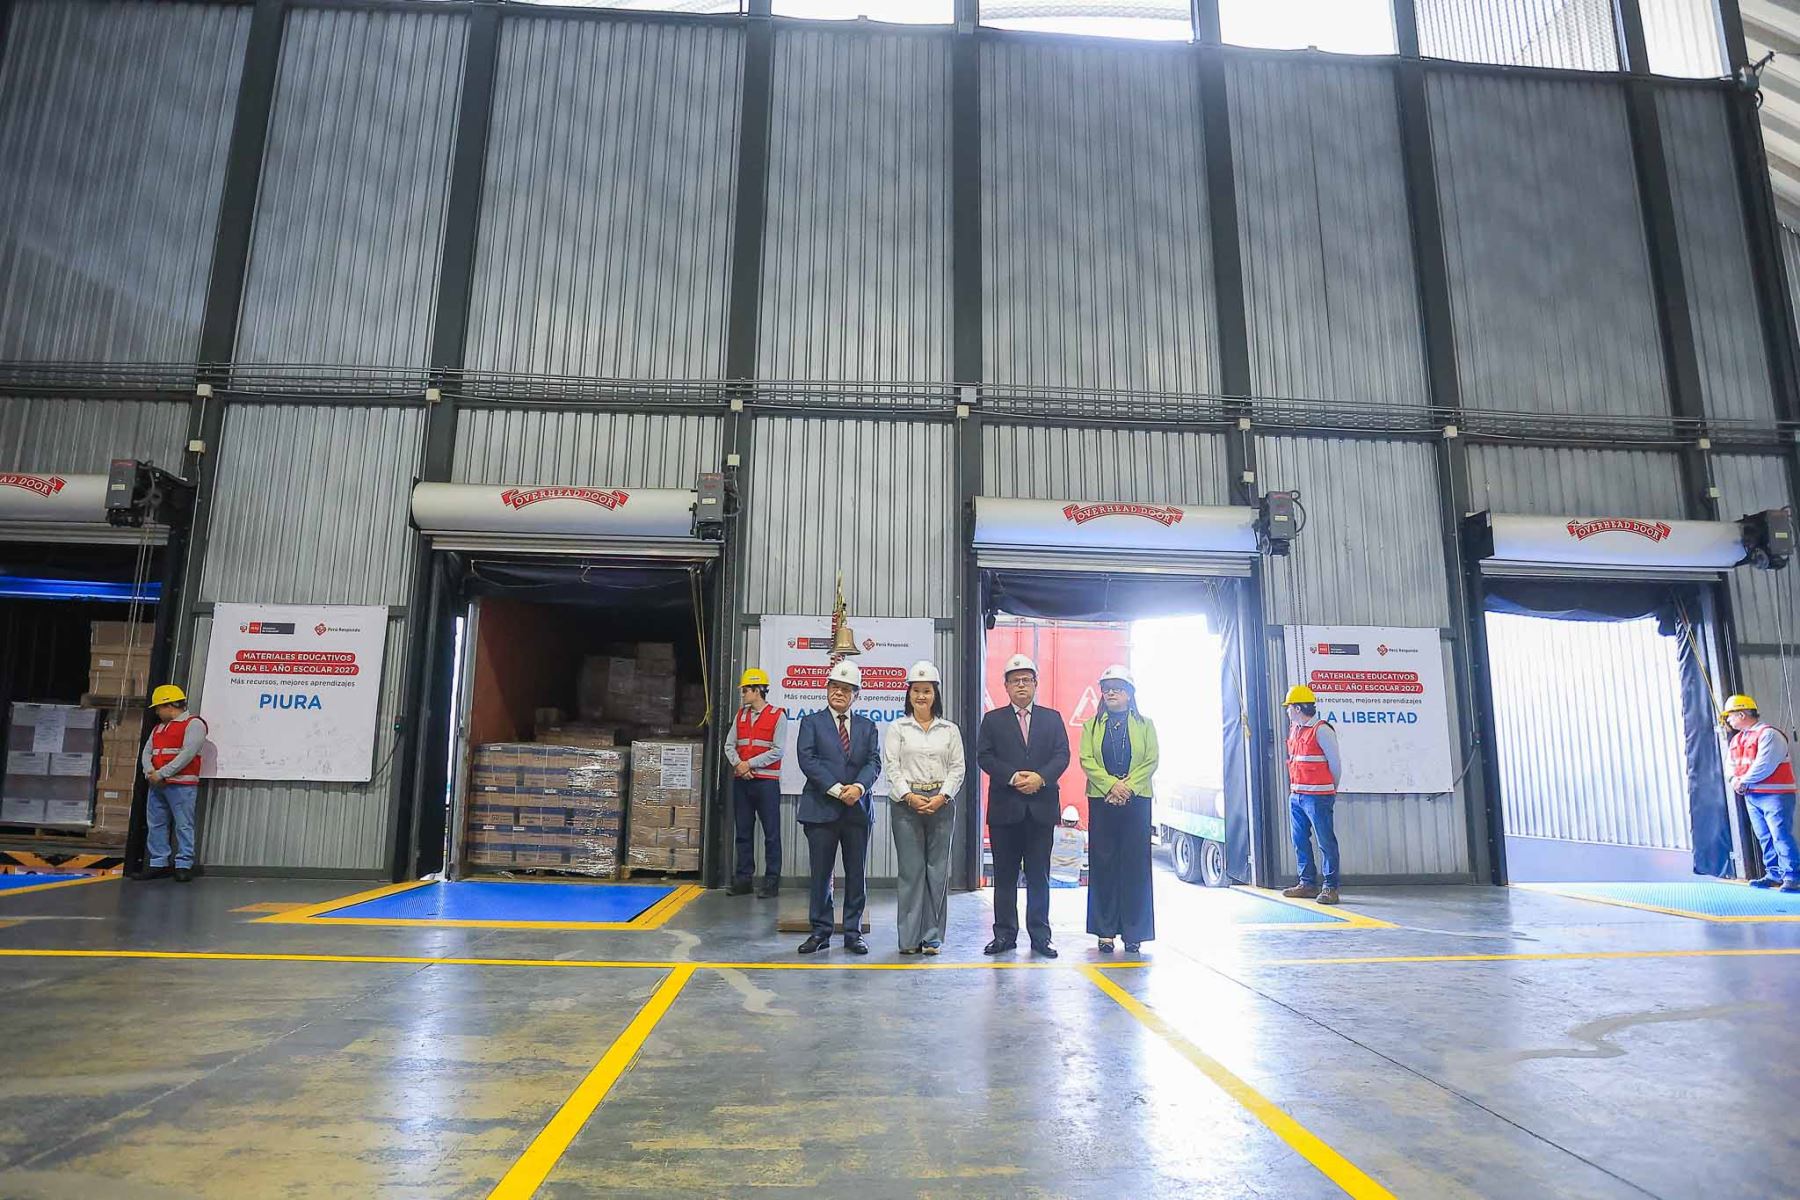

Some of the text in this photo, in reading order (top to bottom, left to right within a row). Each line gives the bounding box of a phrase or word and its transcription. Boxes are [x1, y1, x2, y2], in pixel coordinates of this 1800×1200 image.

[19, 477, 49, 494] DOOR
[515, 489, 614, 507] OVERHEAD DOOR
[1076, 504, 1170, 523] OVERHEAD DOOR
[1578, 519, 1660, 539] OVERHEAD DOOR
[243, 652, 353, 662] MATERIALES EDUCATIVOS
[233, 664, 257, 672] PARA
[271, 662, 291, 673] AÑO
[293, 665, 332, 674] ESCOLAR
[334, 666, 356, 674] 2027
[793, 667, 832, 675] MATERIA
[1317, 672, 1415, 681] MATERIALES EDUCATIVOS
[246, 679, 279, 687] recursos,
[786, 679, 810, 687] PARA
[1345, 682, 1363, 692] AÑO
[1364, 684, 1400, 692] ESCOLAR
[259, 693, 322, 710] PIURA
[1342, 711, 1418, 724] LIBERTAD
